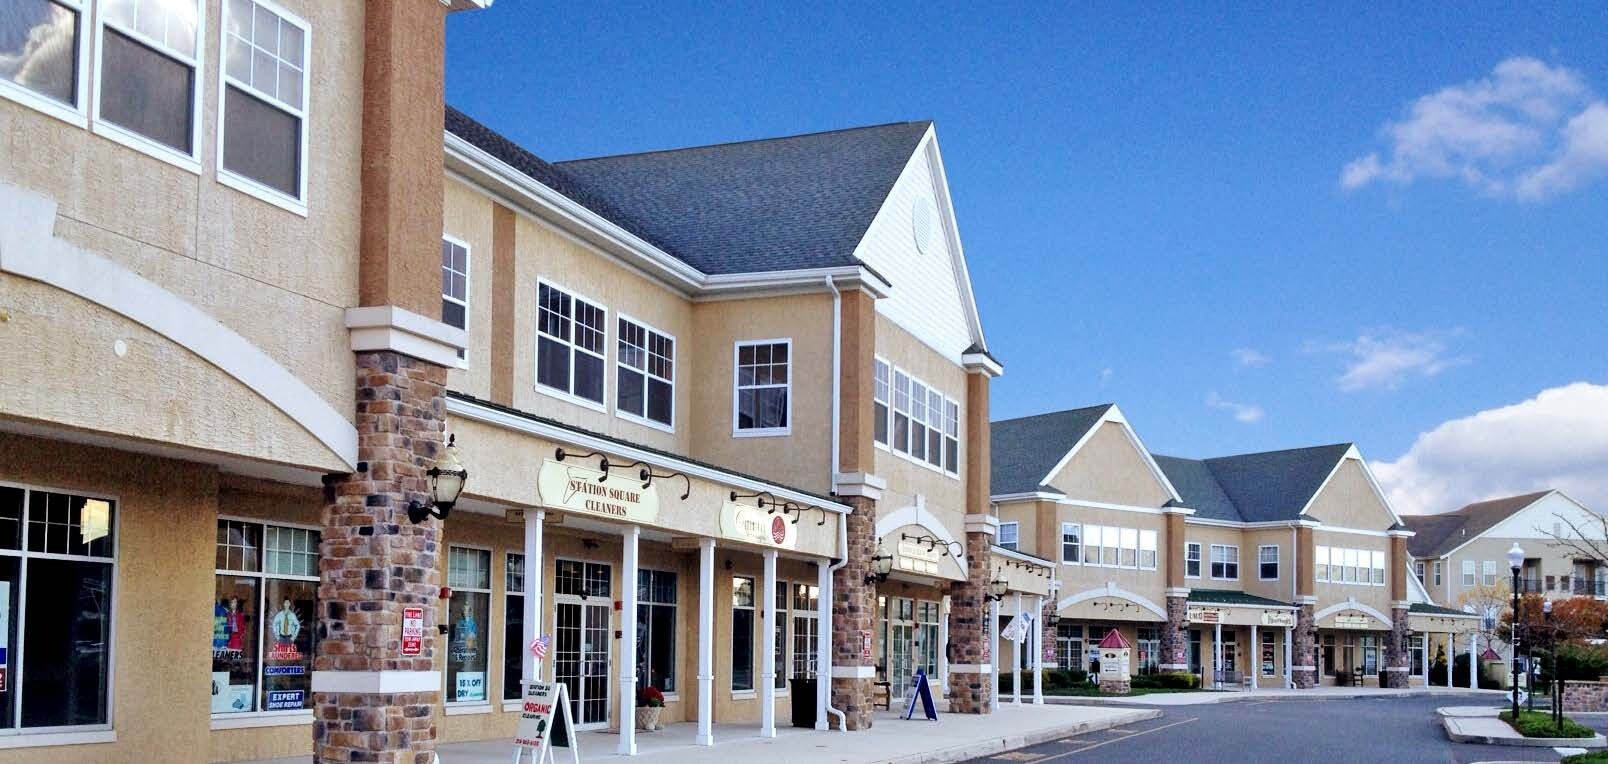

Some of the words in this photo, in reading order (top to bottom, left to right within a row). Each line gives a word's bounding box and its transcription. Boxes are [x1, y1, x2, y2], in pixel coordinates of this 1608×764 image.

[569, 480, 607, 497] STATION
[609, 488, 641, 503] SQUARE
[585, 500, 627, 516] CLEANERS
[404, 627, 421, 636] PARKING
[272, 643, 297, 653] Shirts
[212, 650, 244, 660] LEANERS
[265, 666, 305, 675] COMFORTERS
[472, 679, 481, 687] OFF
[272, 692, 300, 701] EXPERT
[458, 690, 468, 698] DRY
[269, 701, 283, 709] SHOE
[283, 700, 303, 708] REPAIR
[524, 702, 552, 714] ORGANIC
